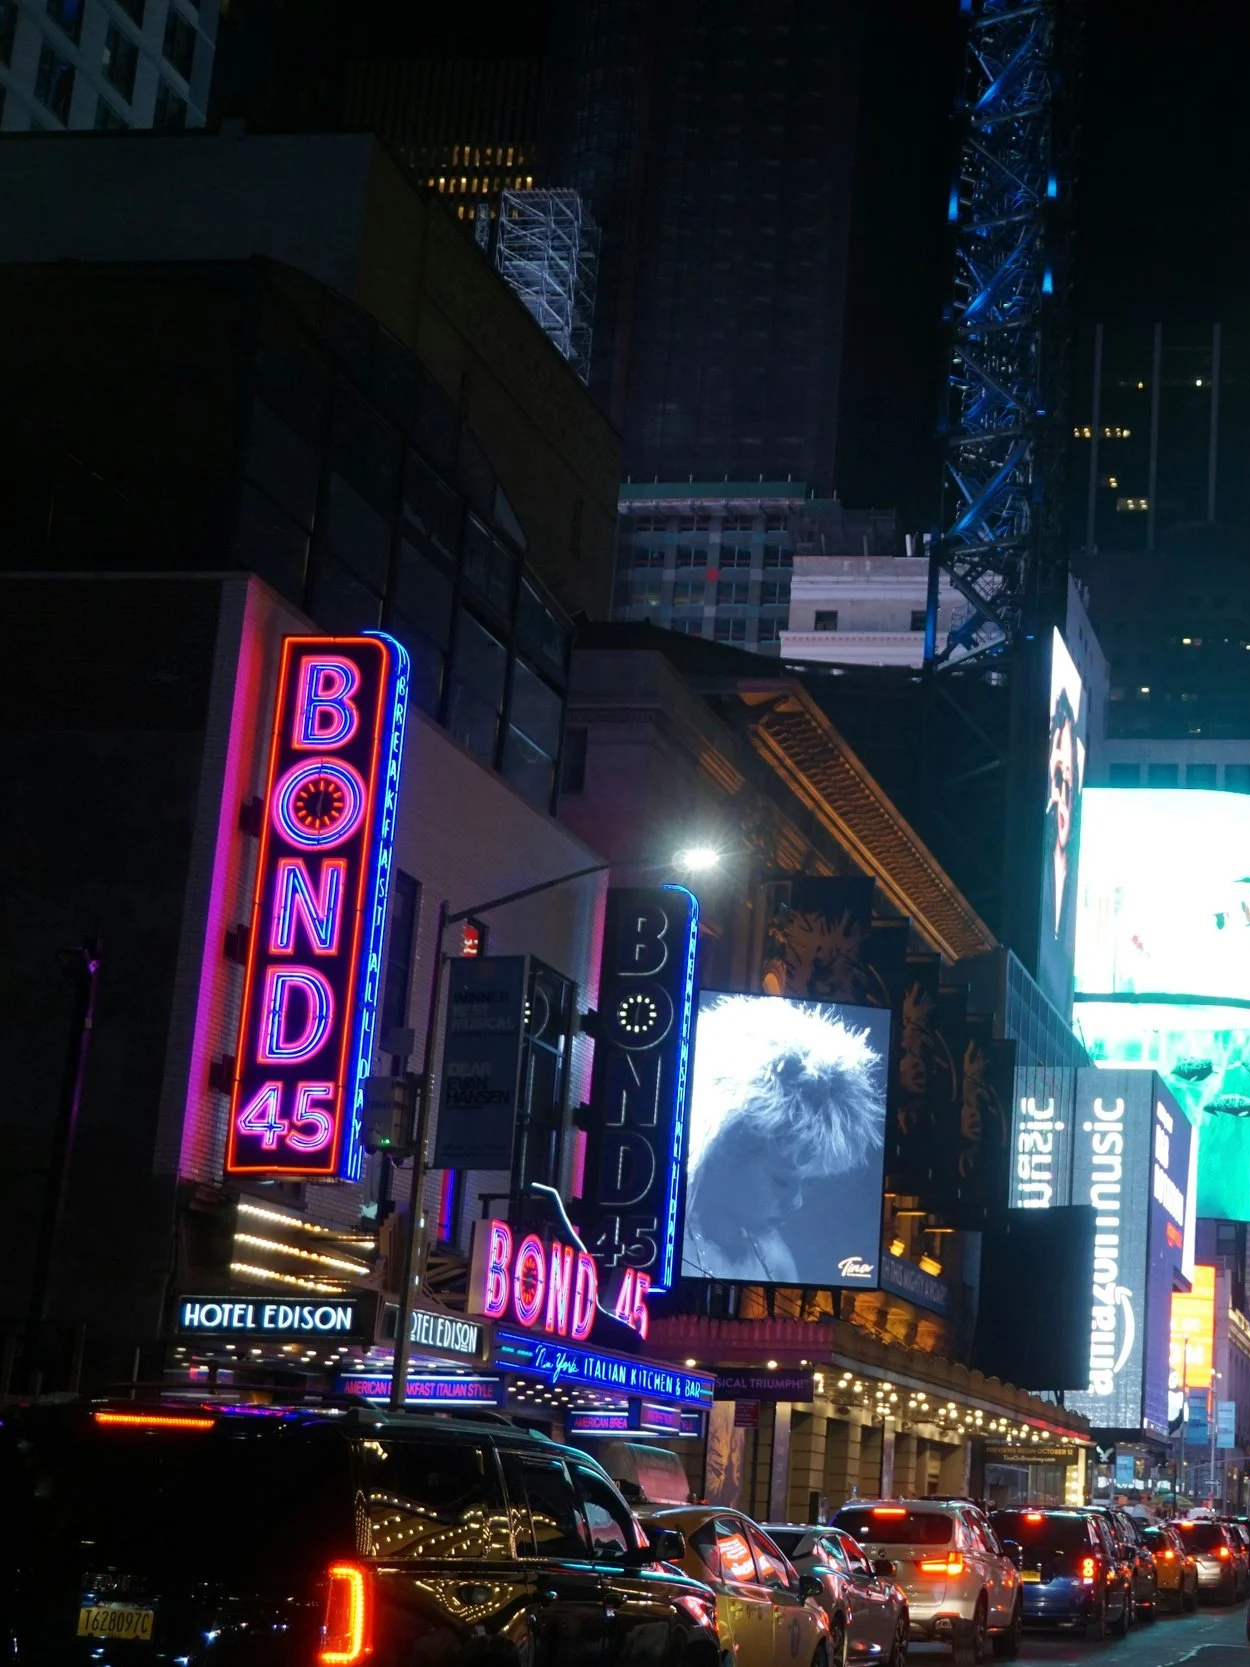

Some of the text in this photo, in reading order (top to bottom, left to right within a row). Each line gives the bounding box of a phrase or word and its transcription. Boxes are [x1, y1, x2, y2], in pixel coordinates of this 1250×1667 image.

[374, 677, 407, 926] BREAKFAST
[257, 655, 367, 1066] BOND
[600, 906, 673, 1206] BOND
[238, 1082, 336, 1151] 45
[590, 1216, 657, 1267] 45
[484, 1218, 652, 1341] BOND 45
[838, 1257, 874, 1277] Tina
[184, 1303, 352, 1330] HOTEL EDISON
[411, 1312, 478, 1353] OTEL EDISON
[344, 1381, 384, 1395] AMERICAN
[436, 1383, 466, 1397] ITALIAN
[467, 1383, 493, 1398] STYLE
[584, 1358, 627, 1384] ITALIAN
[630, 1369, 673, 1393] KITCHEN
[675, 1378, 681, 1395] &
[685, 1380, 702, 1398] BAR
[575, 1417, 609, 1429] AMERICAN
[85, 1609, 150, 1633] T628097C
